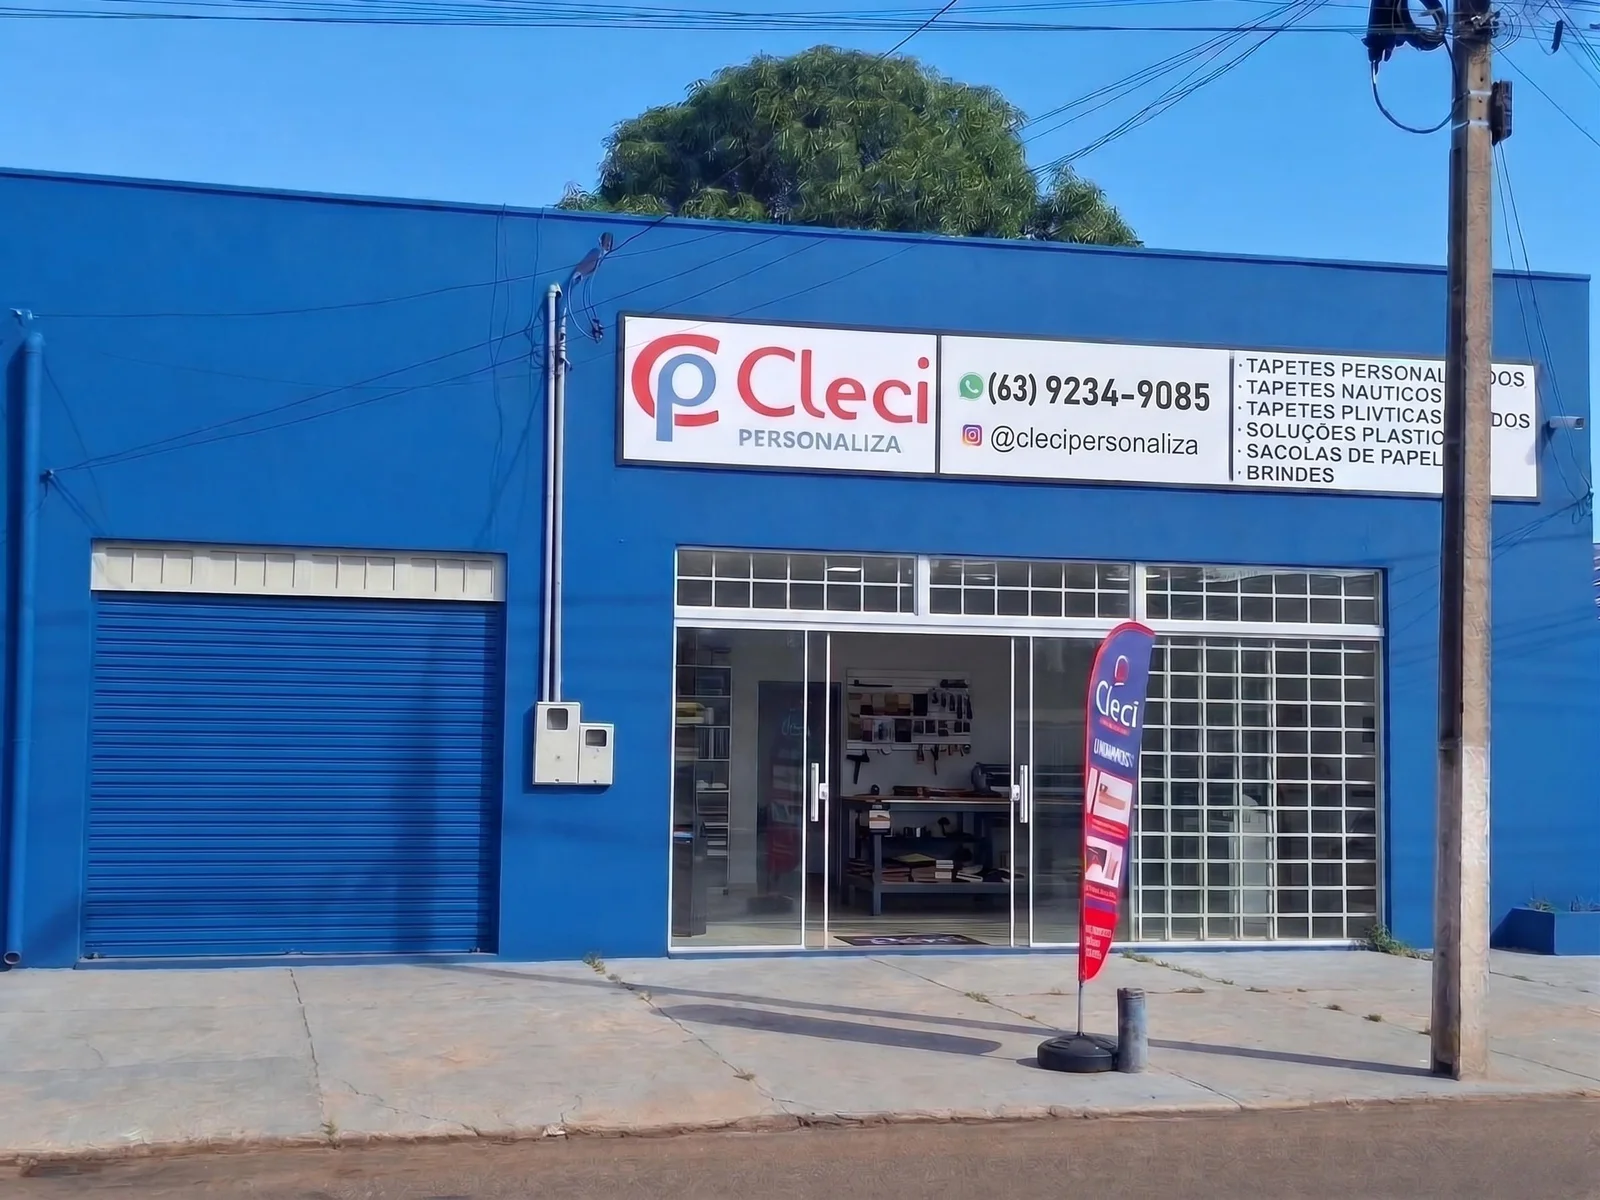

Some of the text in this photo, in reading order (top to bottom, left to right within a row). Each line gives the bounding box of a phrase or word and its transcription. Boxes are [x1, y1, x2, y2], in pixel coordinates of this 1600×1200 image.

[1246, 358, 1336, 377] TAPETES
[737, 346, 930, 424] Cleci
[988, 371, 1211, 412] (63) 9234-9085
[1246, 379, 1442, 404] TAPETES NAUTICOS
[1246, 400, 1336, 420] TAPETES
[1341, 404, 1442, 425] PLIVTICAS
[738, 429, 902, 454] PERSONALIZA
[990, 425, 1199, 455] @clecipersonaliza
[1246, 422, 1356, 444] SOLUÇÕES
[1246, 443, 1444, 467] SACOLAS DE PAPEL
[1246, 465, 1335, 483] BRINDES
[1095, 679, 1140, 728] Cleci
